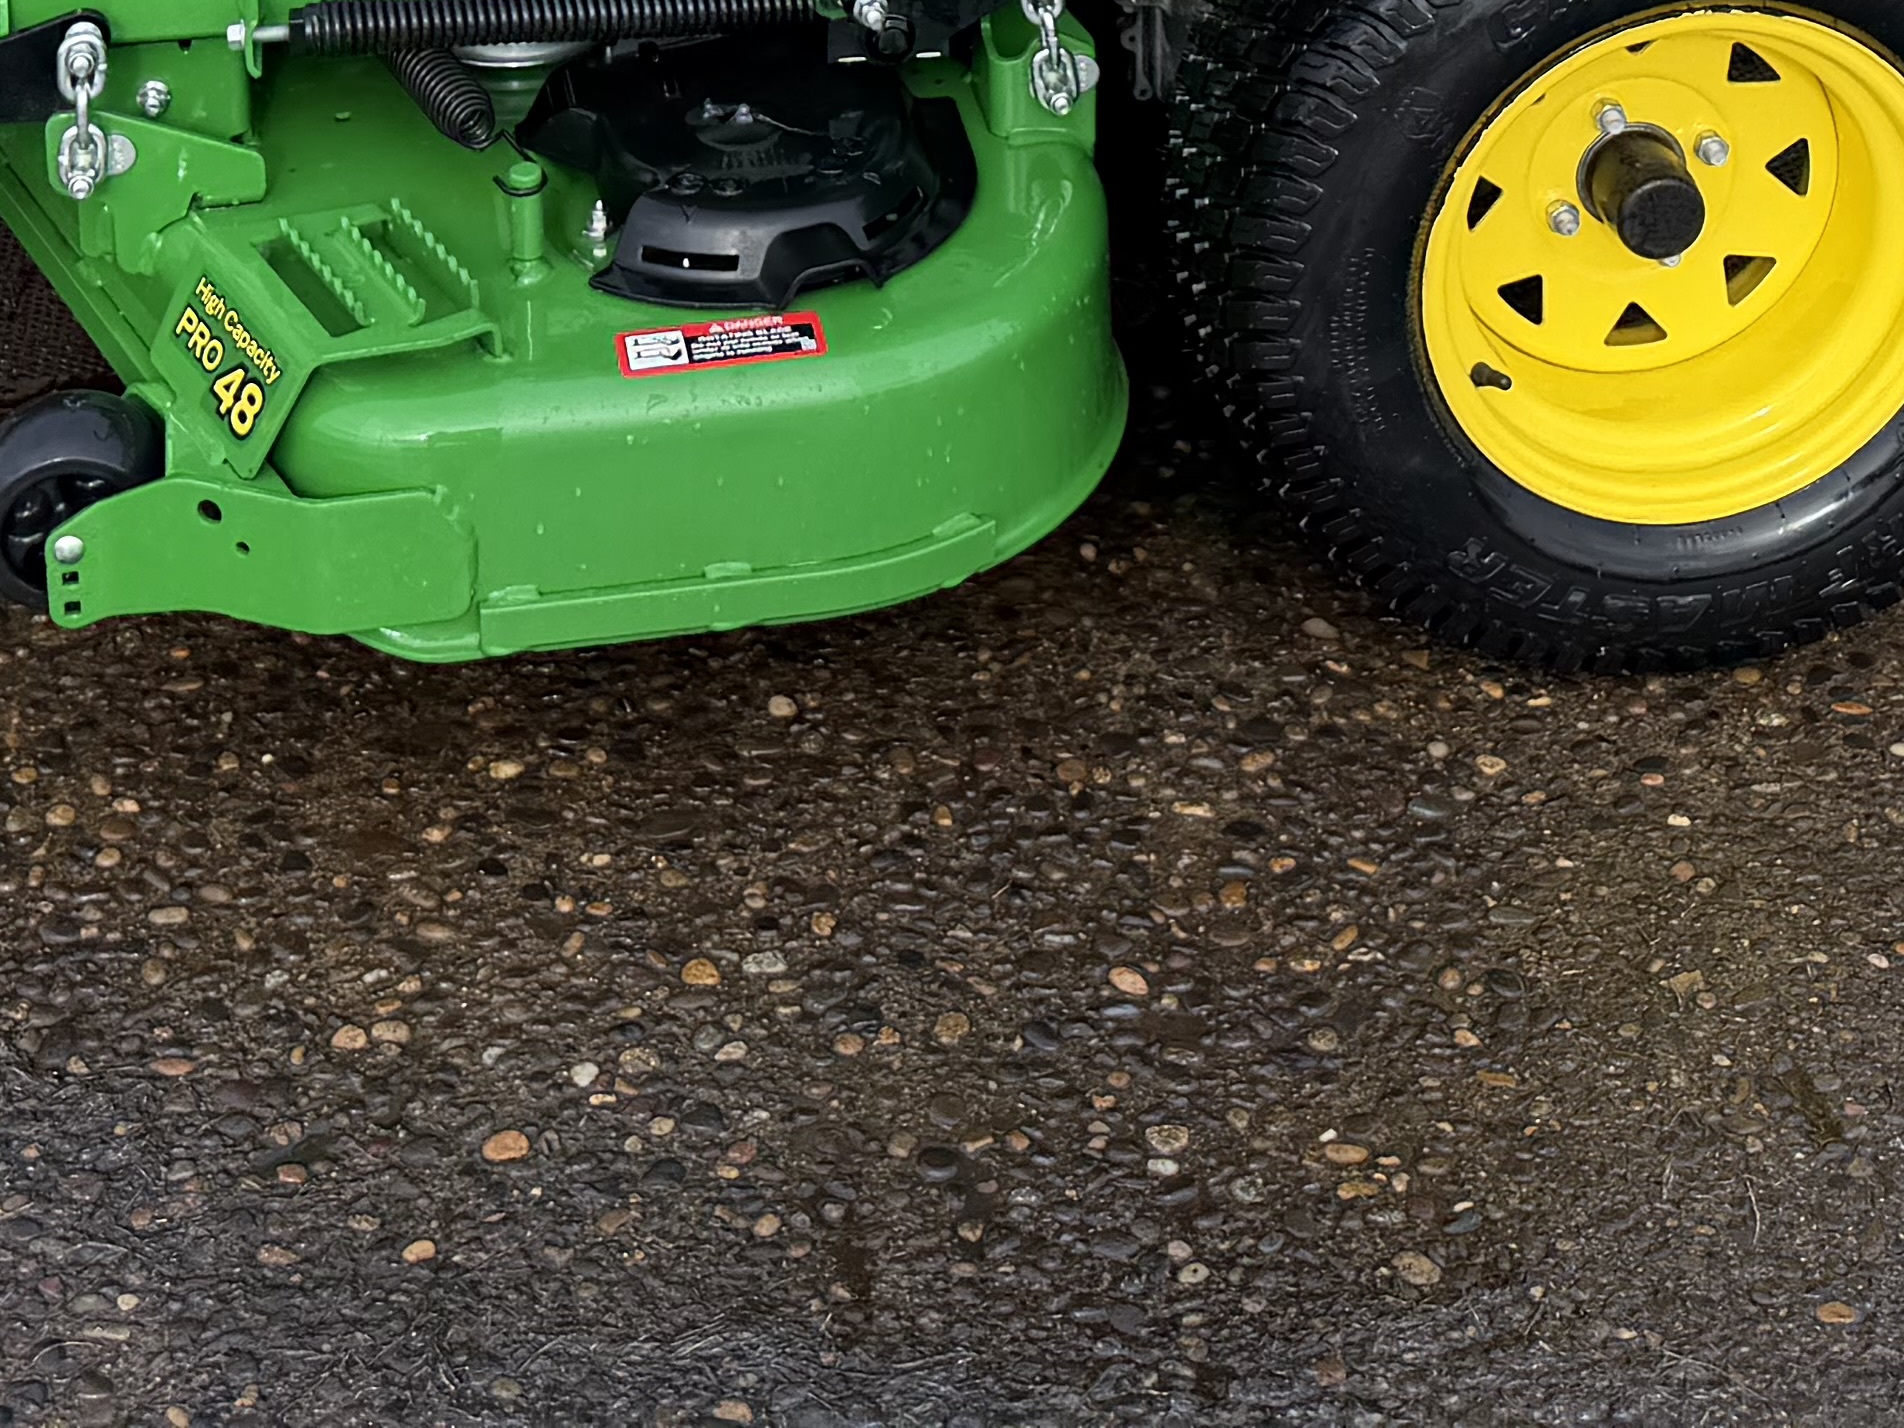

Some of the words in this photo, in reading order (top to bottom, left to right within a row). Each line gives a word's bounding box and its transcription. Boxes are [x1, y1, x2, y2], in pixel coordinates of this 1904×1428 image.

[175, 306, 225, 373] PRO
[211, 366, 265, 439] 48
[195, 276, 227, 321] High
[223, 309, 281, 385] Capacity
[723, 316, 783, 331] DANGER
